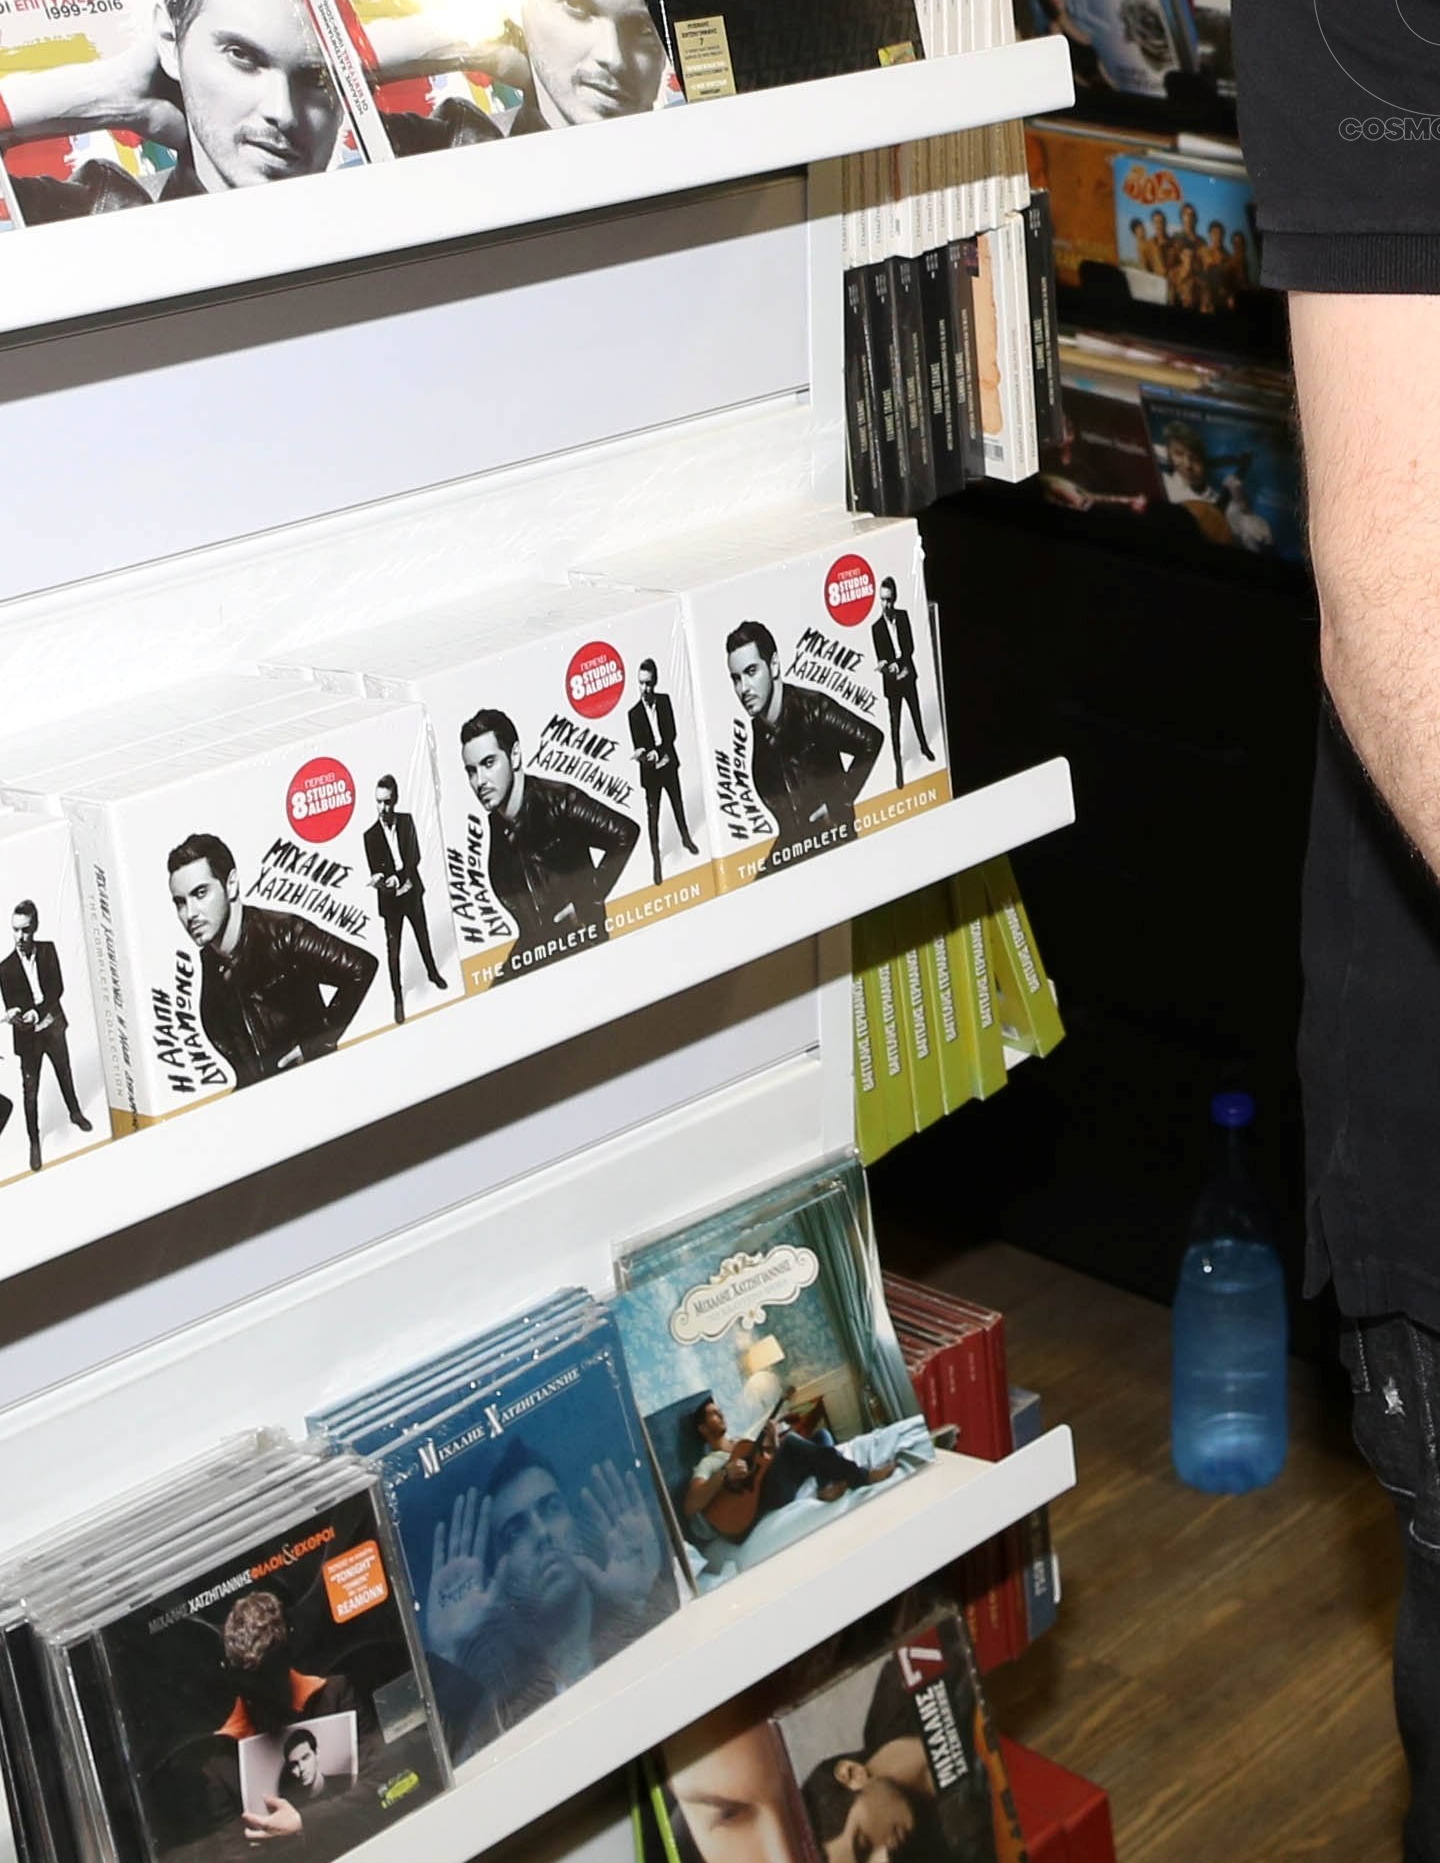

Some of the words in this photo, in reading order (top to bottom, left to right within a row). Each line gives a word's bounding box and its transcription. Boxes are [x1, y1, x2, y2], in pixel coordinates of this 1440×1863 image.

[828, 584, 840, 607] 8
[840, 574, 869, 593] STUDIO
[840, 583, 874, 604] ALBUMS
[570, 676, 584, 701] 8
[583, 660, 617, 685] STUDIO
[584, 670, 623, 696] ALBUMS
[291, 791, 307, 820] 8
[307, 780, 346, 803] STUDIO
[308, 791, 353, 817] ALBUMS
[730, 822, 750, 840] Η
[738, 857, 768, 880] THE
[772, 823, 849, 867] COMPLETE
[853, 788, 938, 831] COLLECTION
[459, 923, 485, 943] Η
[471, 961, 504, 986] THE
[509, 923, 599, 971] COMPLETE
[604, 883, 702, 932] COLLECTION
[168, 1074, 196, 1093] Η
[417, 1424, 487, 1479] ΜΙΧΑΛΗΣ
[484, 1367, 581, 1438] ΧΑΤΖΗΓΙΑΝΝΗΣ
[337, 1584, 385, 1616] REAMONN
[915, 1686, 958, 1789] ΜΙΧΑΛΗΣ
